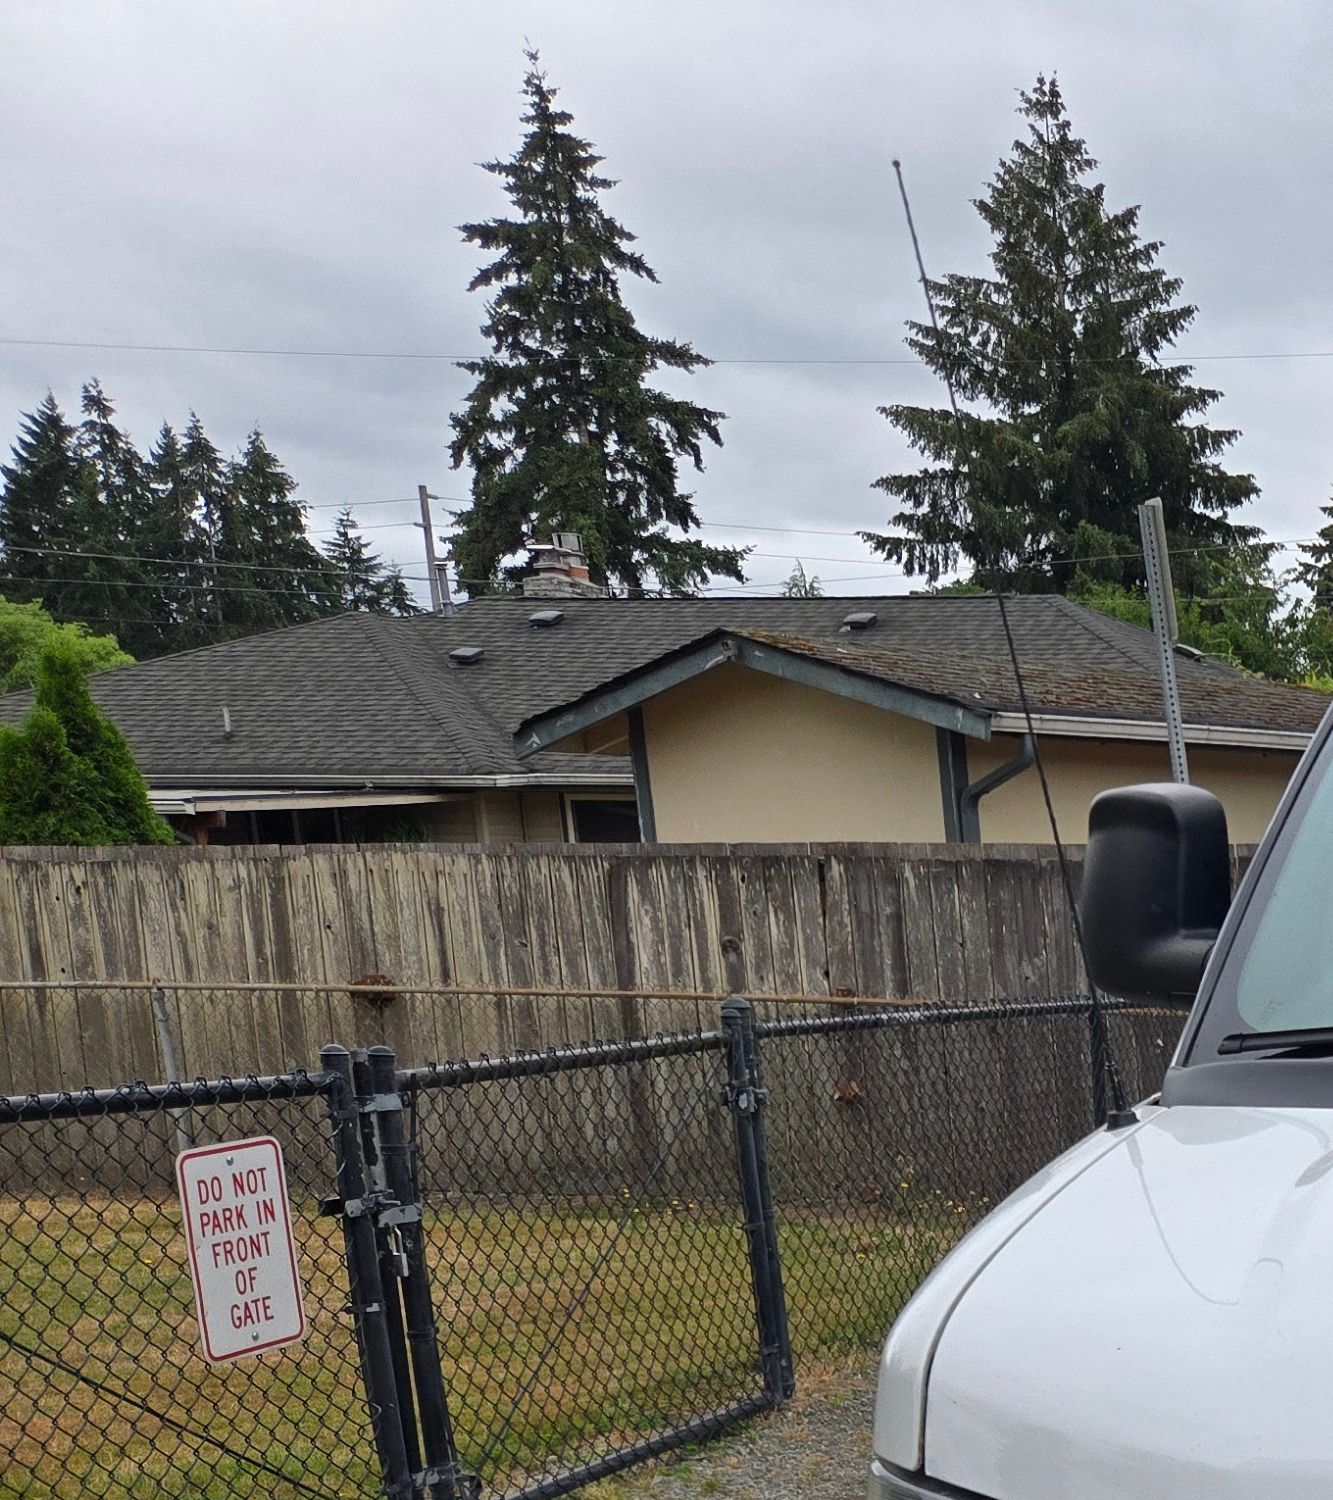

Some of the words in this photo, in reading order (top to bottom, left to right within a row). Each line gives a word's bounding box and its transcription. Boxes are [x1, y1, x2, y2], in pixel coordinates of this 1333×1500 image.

[197, 1176, 222, 1205] DO
[232, 1167, 267, 1198] NOT
[200, 1204, 248, 1238] PARK
[256, 1198, 276, 1225] IN
[211, 1232, 271, 1268] FRONT
[235, 1267, 258, 1295] OF
[231, 1296, 274, 1329] GATE
